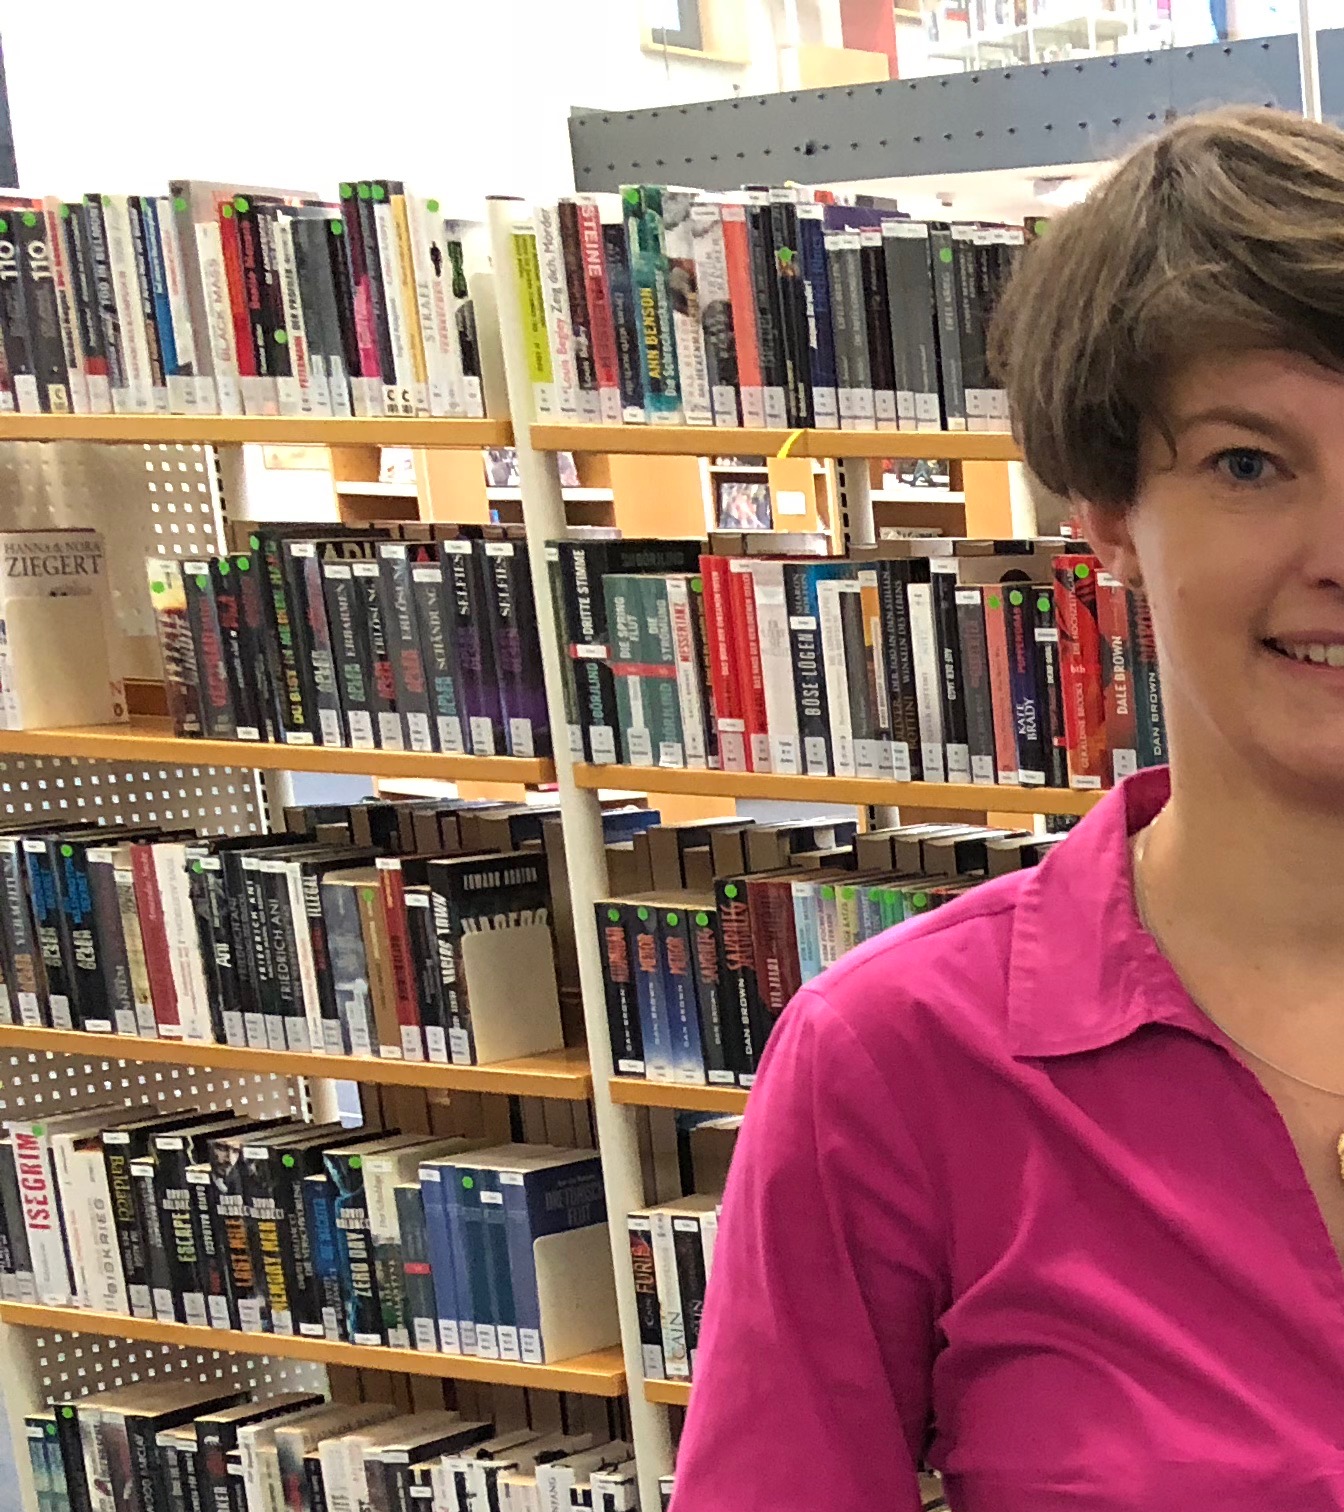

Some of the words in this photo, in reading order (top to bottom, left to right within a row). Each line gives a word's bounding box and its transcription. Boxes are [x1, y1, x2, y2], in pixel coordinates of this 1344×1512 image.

[27, 240, 51, 281] 110
[580, 206, 602, 277] STEINE
[640, 287, 656, 345] BENSON
[646, 351, 661, 378] ANN
[5, 554, 103, 577] ZIEGERT
[572, 549, 589, 594] STIMME
[580, 597, 595, 635] DRITTE
[619, 640, 631, 658] DIE
[797, 632, 818, 676] LÜGEN
[899, 638, 911, 684] WINKELN
[1112, 636, 1127, 681] BROWN
[286, 670, 302, 702] BIST
[801, 682, 821, 716] BÖSE
[1116, 684, 1128, 715] DALE
[1148, 672, 1160, 722] BROWN
[291, 705, 304, 724] DU
[1016, 703, 1026, 735] KATE
[1023, 697, 1037, 740] BRADY
[1152, 727, 1162, 756] DAN
[245, 880, 257, 904] ANI
[303, 875, 320, 917] ILLEGAL
[268, 898, 281, 925] ANI
[431, 892, 451, 935] TOWN
[215, 943, 232, 967] Ani
[250, 911, 268, 980] FRIEDRICH
[272, 930, 293, 1000] FRIEDRICH
[620, 989, 630, 1029] BROWN
[650, 982, 658, 1020] BROWN
[678, 984, 687, 1022] BROWN
[710, 990, 719, 1026] BROWN
[738, 978, 751, 1026] BROWN
[745, 1031, 753, 1055] DAN
[15, 1133, 51, 1230] ISEGRIM
[109, 1155, 133, 1222] Baldacci
[171, 1212, 197, 1262] ESCAPE
[345, 1231, 366, 1258] DAY
[231, 1254, 254, 1286] LAST
[350, 1263, 372, 1297] ZERO
[666, 1311, 687, 1360] CAIN
